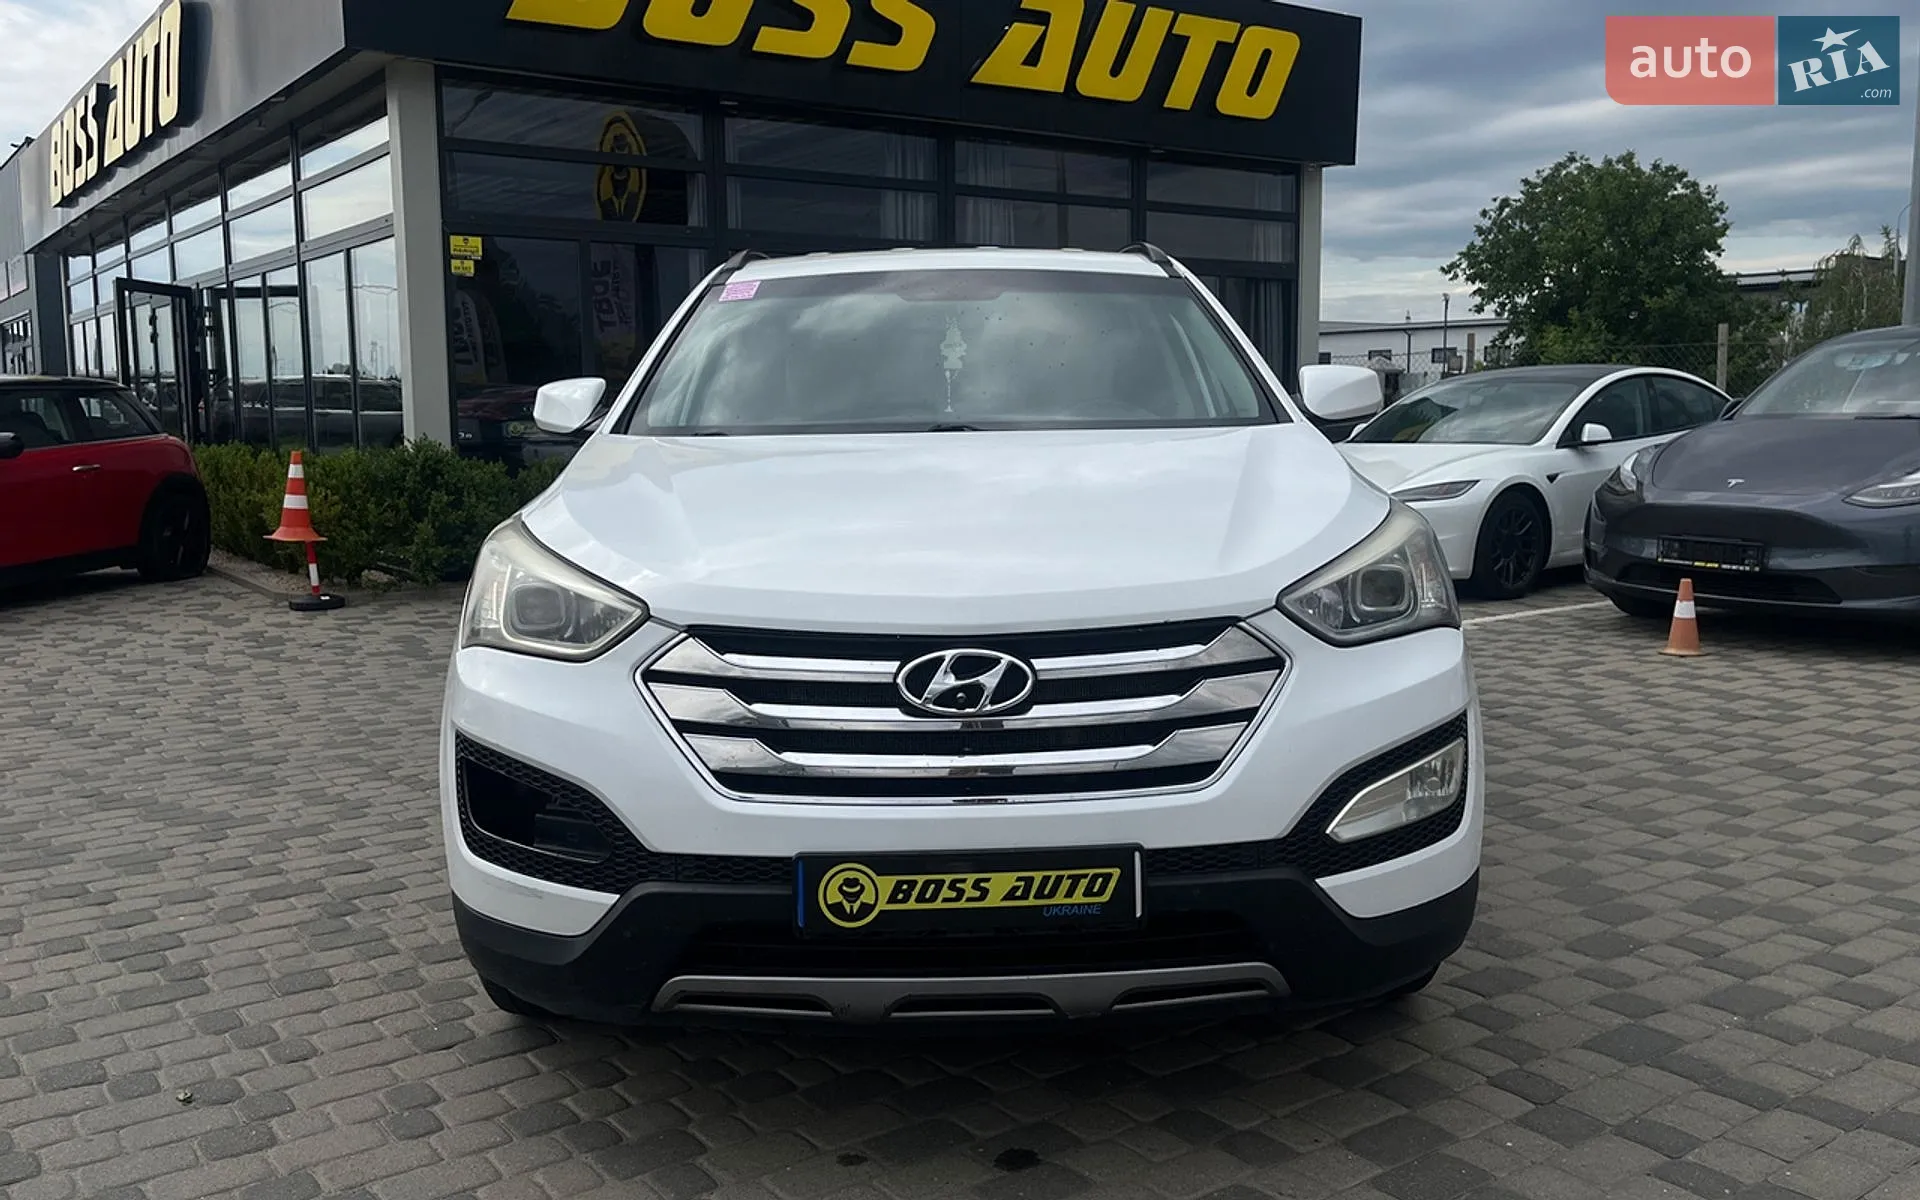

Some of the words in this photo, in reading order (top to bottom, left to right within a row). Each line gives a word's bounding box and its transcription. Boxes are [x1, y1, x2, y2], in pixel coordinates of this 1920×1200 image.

[506, 0, 937, 72] SS
[970, 0, 1301, 120] AUTO
[51, 82, 99, 208] BOSS
[104, 0, 182, 168] AUTO
[886, 878, 993, 904] BOSS
[1000, 872, 1113, 901] AUTO
[1043, 904, 1102, 918] UKRAINE
